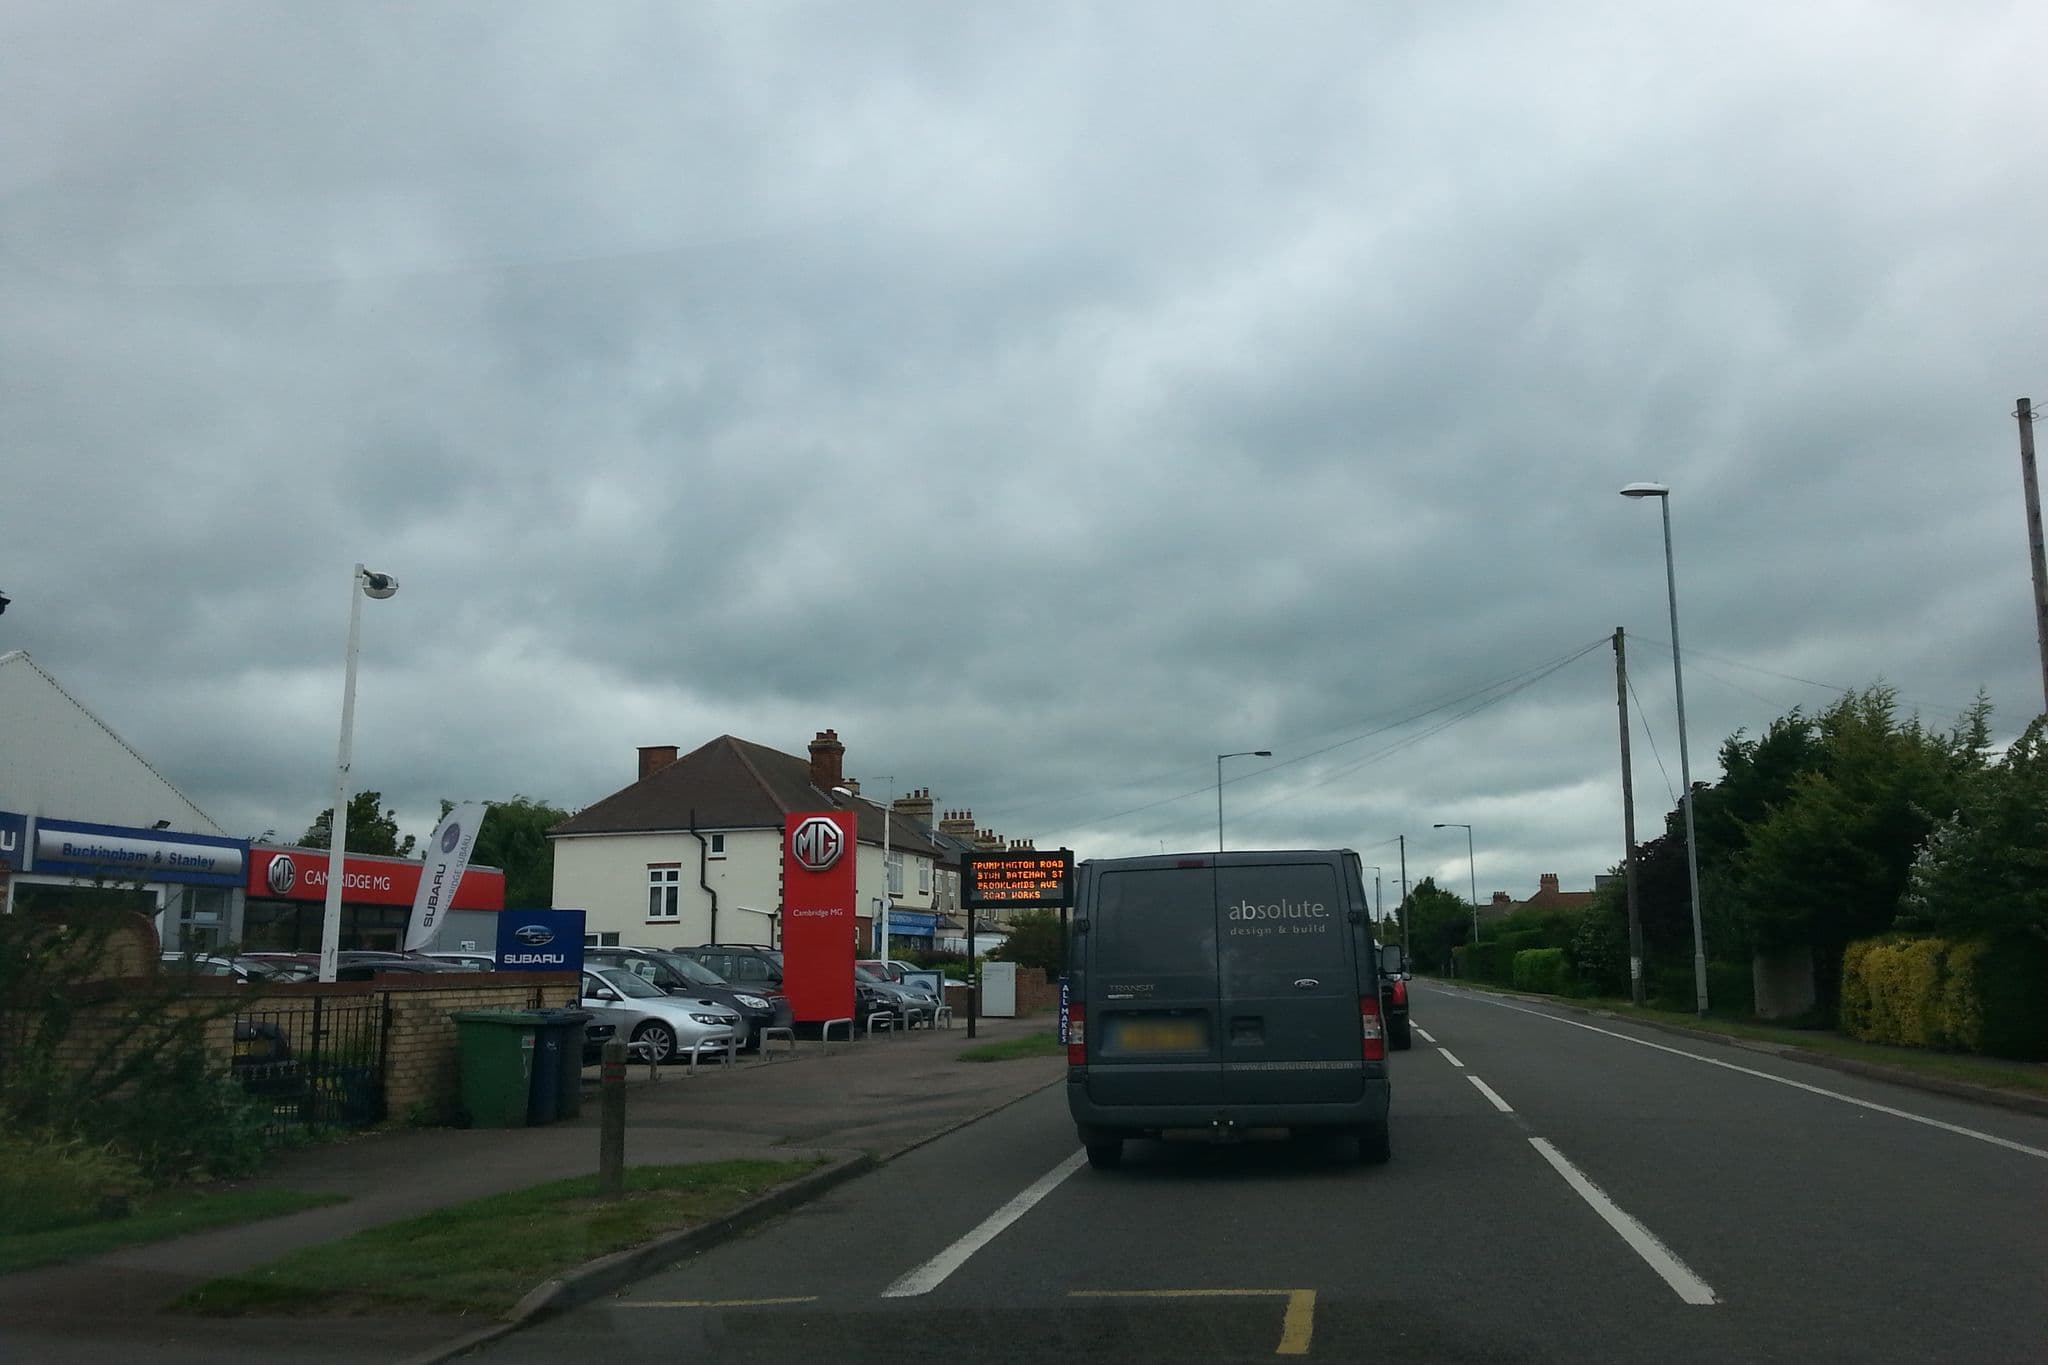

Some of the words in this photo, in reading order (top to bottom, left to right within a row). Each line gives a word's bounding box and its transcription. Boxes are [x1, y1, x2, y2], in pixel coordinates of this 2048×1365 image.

[456, 834, 473, 869] SUBARU
[798, 823, 836, 864] MG
[62, 842, 148, 864] Buckingham
[153, 851, 162, 863] &
[168, 851, 215, 869] Stanley
[1040, 860, 1064, 869] ROAD
[304, 870, 371, 889] CAMRIDGE
[373, 875, 390, 891] MG
[1006, 871, 1046, 879] BATEMAN
[1051, 870, 1063, 878] ST
[977, 881, 1035, 890] BROOKLANDS
[1040, 880, 1057, 889] AVE
[423, 864, 447, 928] SUBARU
[983, 891, 1006, 900] ROAD
[1011, 891, 1041, 899] WORKS
[793, 908, 829, 917] Cambridge
[830, 908, 843, 916] MG
[1230, 927, 1272, 937] design
[1278, 924, 1287, 934] &
[1293, 924, 1326, 934] build
[503, 954, 565, 964] SUBARU
[1062, 985, 1070, 1005] ALL
[1061, 1008, 1069, 1043] MAKES
